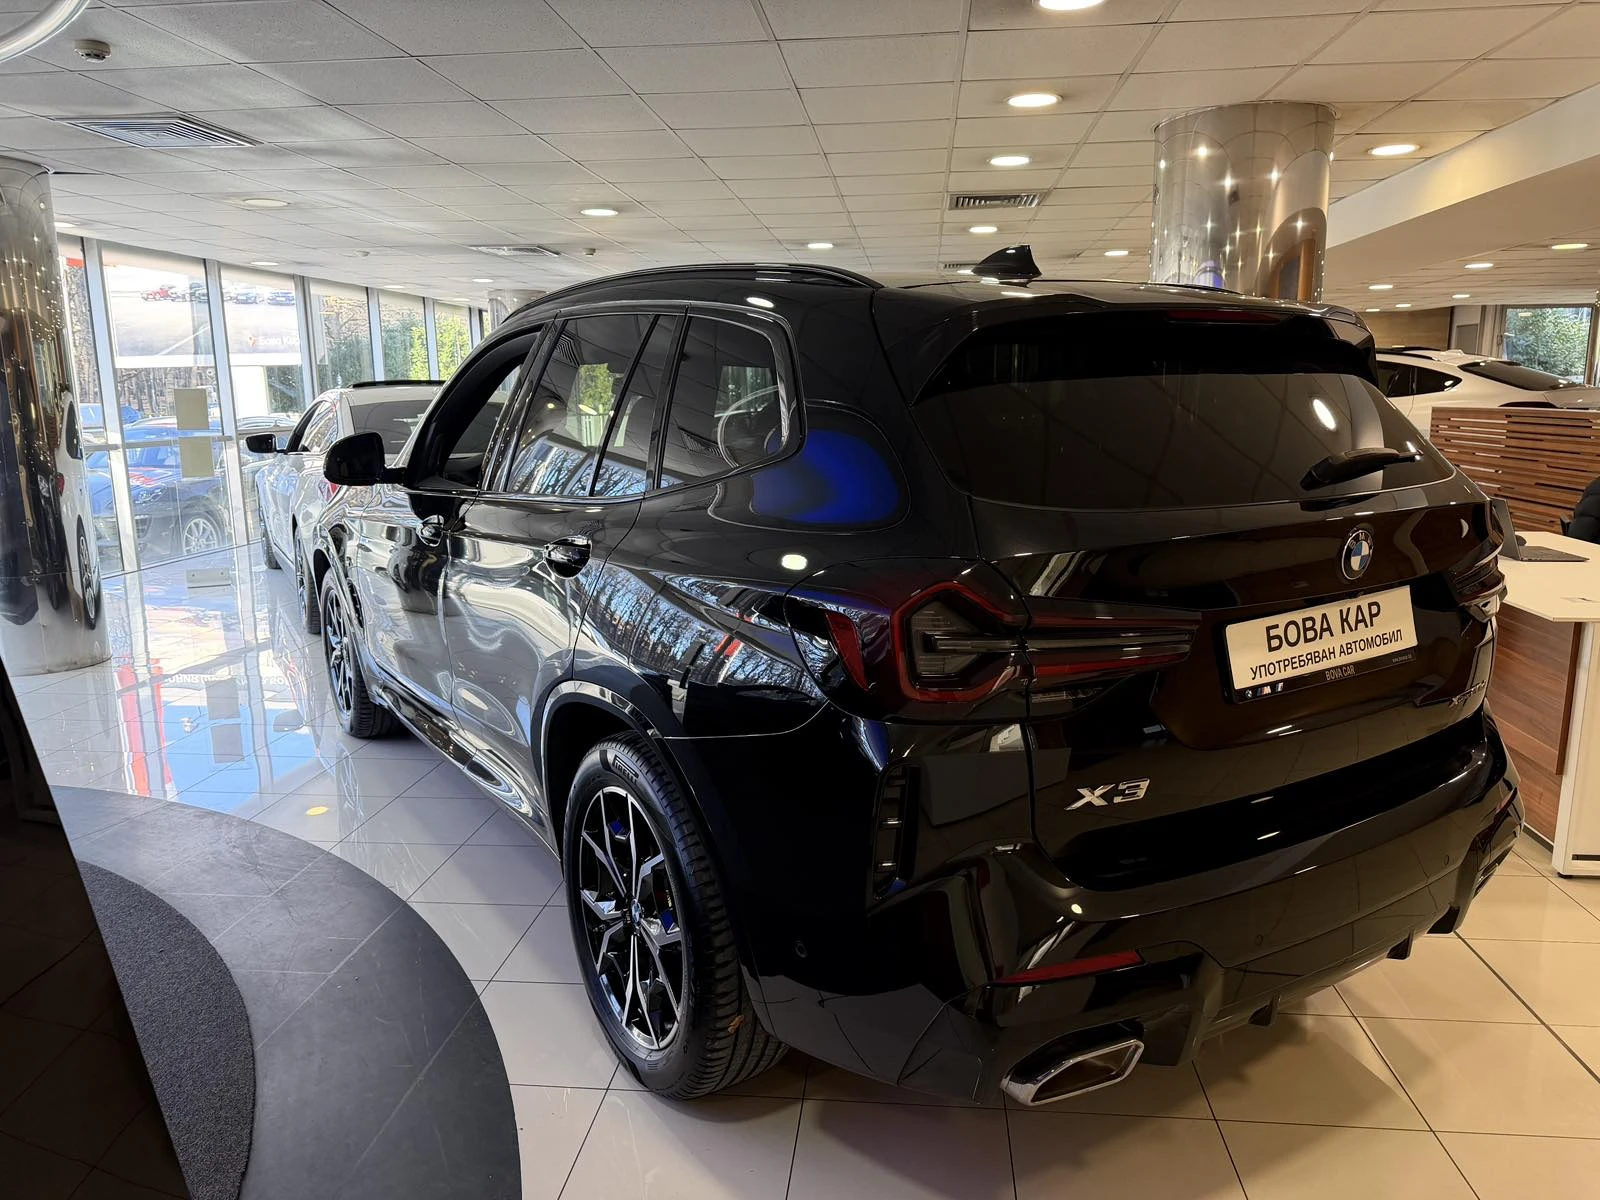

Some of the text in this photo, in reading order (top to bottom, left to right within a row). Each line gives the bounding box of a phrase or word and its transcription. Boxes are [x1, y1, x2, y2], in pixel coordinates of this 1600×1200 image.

[1265, 600, 1382, 653] БОВА КАР
[1250, 628, 1403, 680] УПОТРЕБЯВАН АВТОМОБИЛ
[1325, 664, 1356, 681] BOVA CAR
[612, 754, 639, 785] PIRELLI
[1064, 777, 1150, 811] X3
